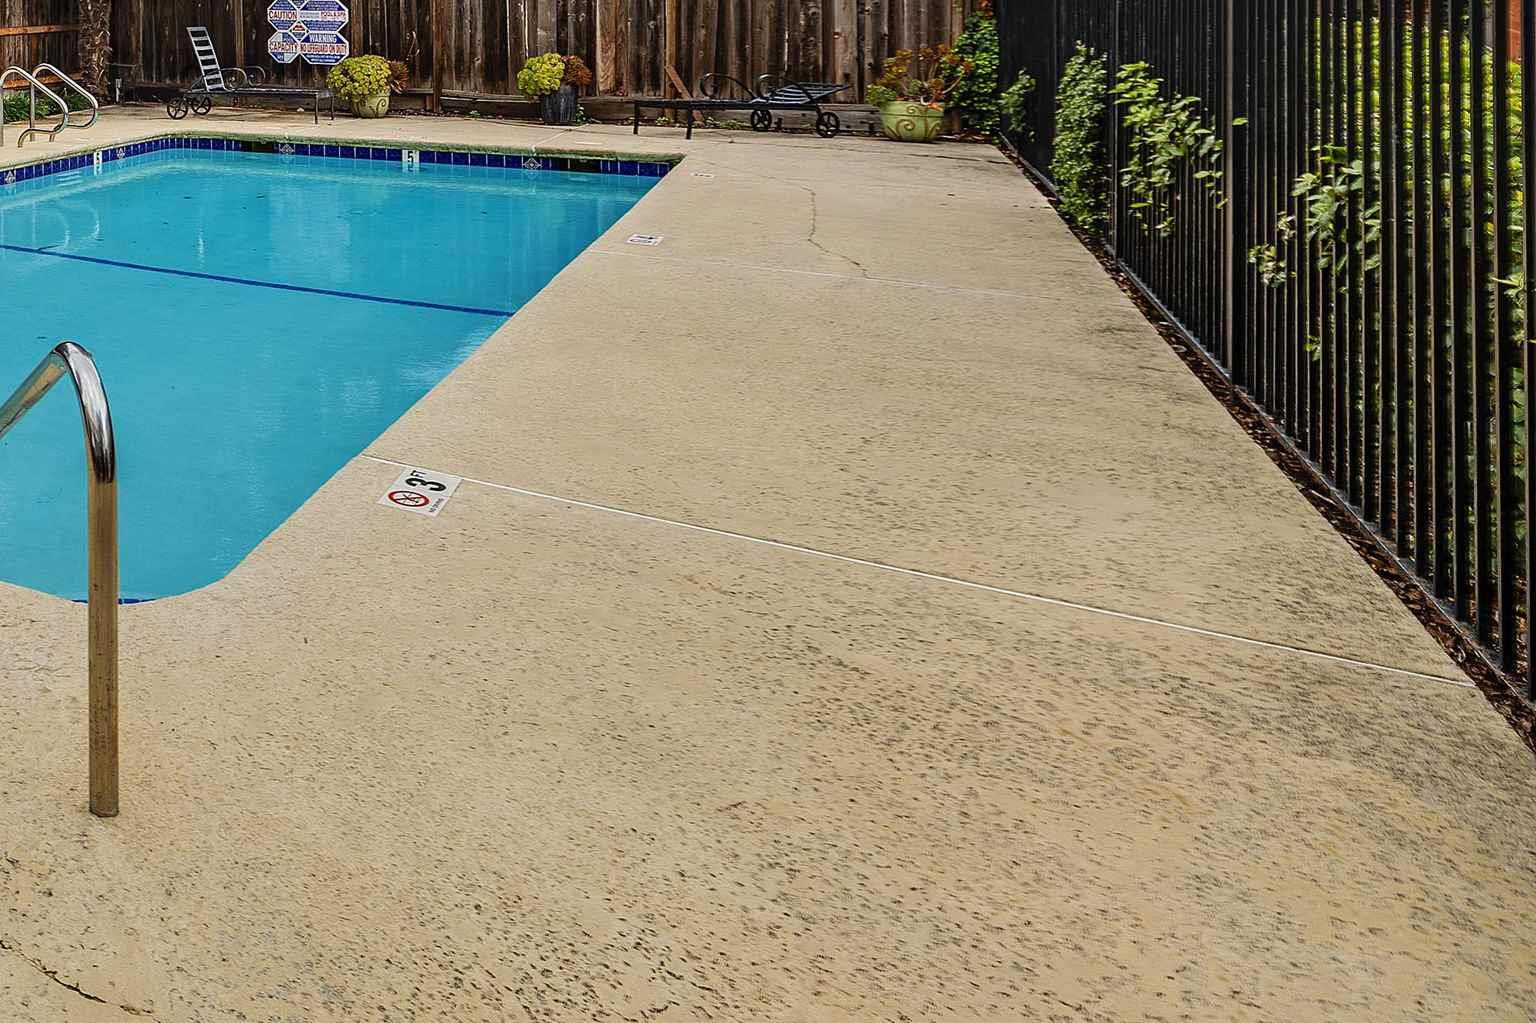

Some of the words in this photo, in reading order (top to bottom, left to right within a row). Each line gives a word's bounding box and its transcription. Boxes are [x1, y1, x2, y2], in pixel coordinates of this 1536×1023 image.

[269, 11, 297, 19] CAUTION
[309, 34, 337, 43] WARNING
[270, 42, 298, 51] CAPACITY
[300, 44, 307, 52] NO
[307, 44, 328, 53] LIFEGUARD
[407, 150, 414, 163] 5
[410, 470, 427, 478] FT
[405, 478, 447, 492] 3
